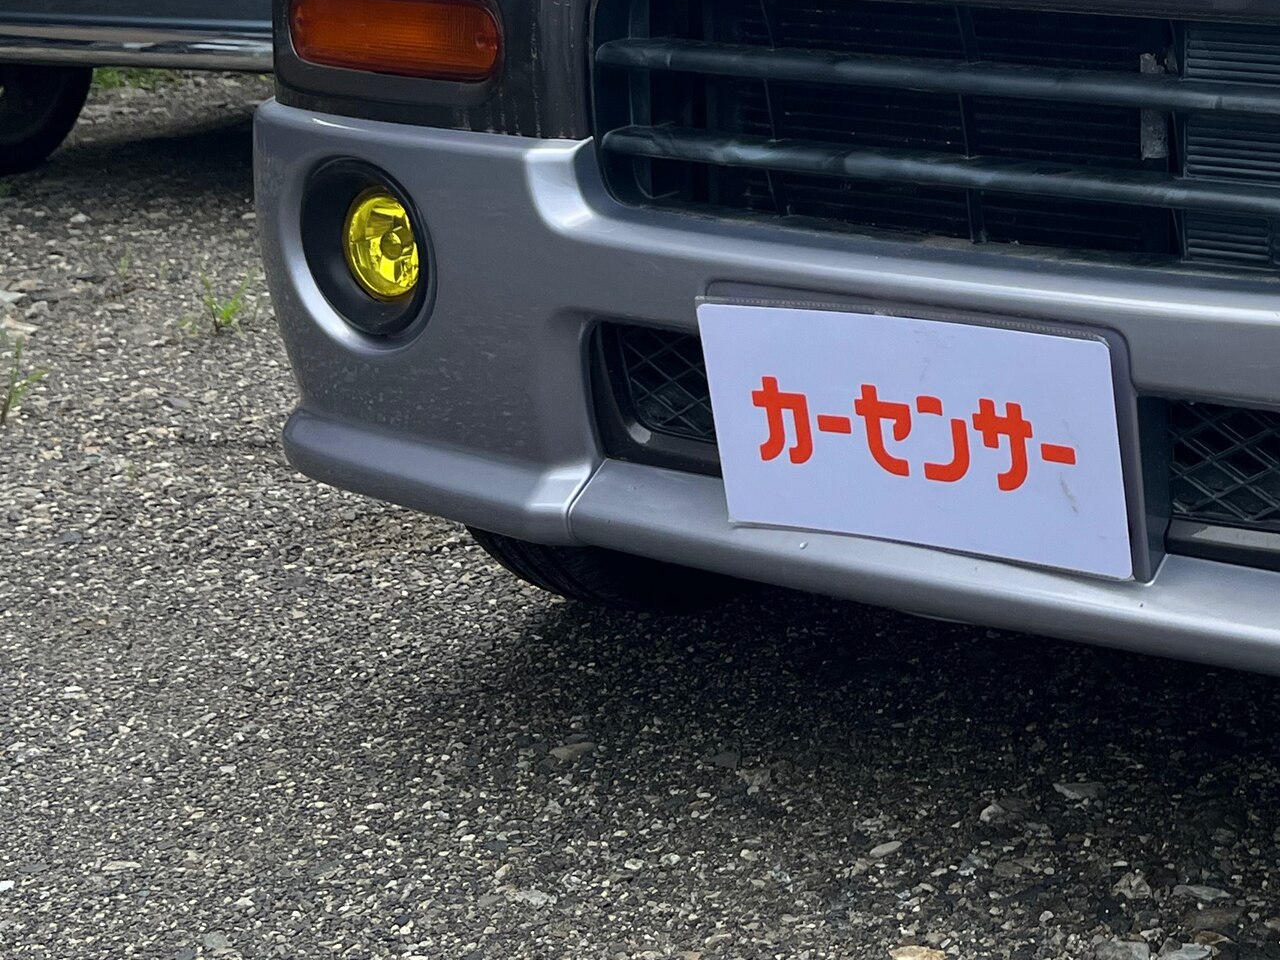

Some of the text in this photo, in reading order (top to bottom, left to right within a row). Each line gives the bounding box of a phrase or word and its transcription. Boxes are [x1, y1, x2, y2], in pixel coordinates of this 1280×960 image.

[751, 375, 1077, 492] カーセンサー
